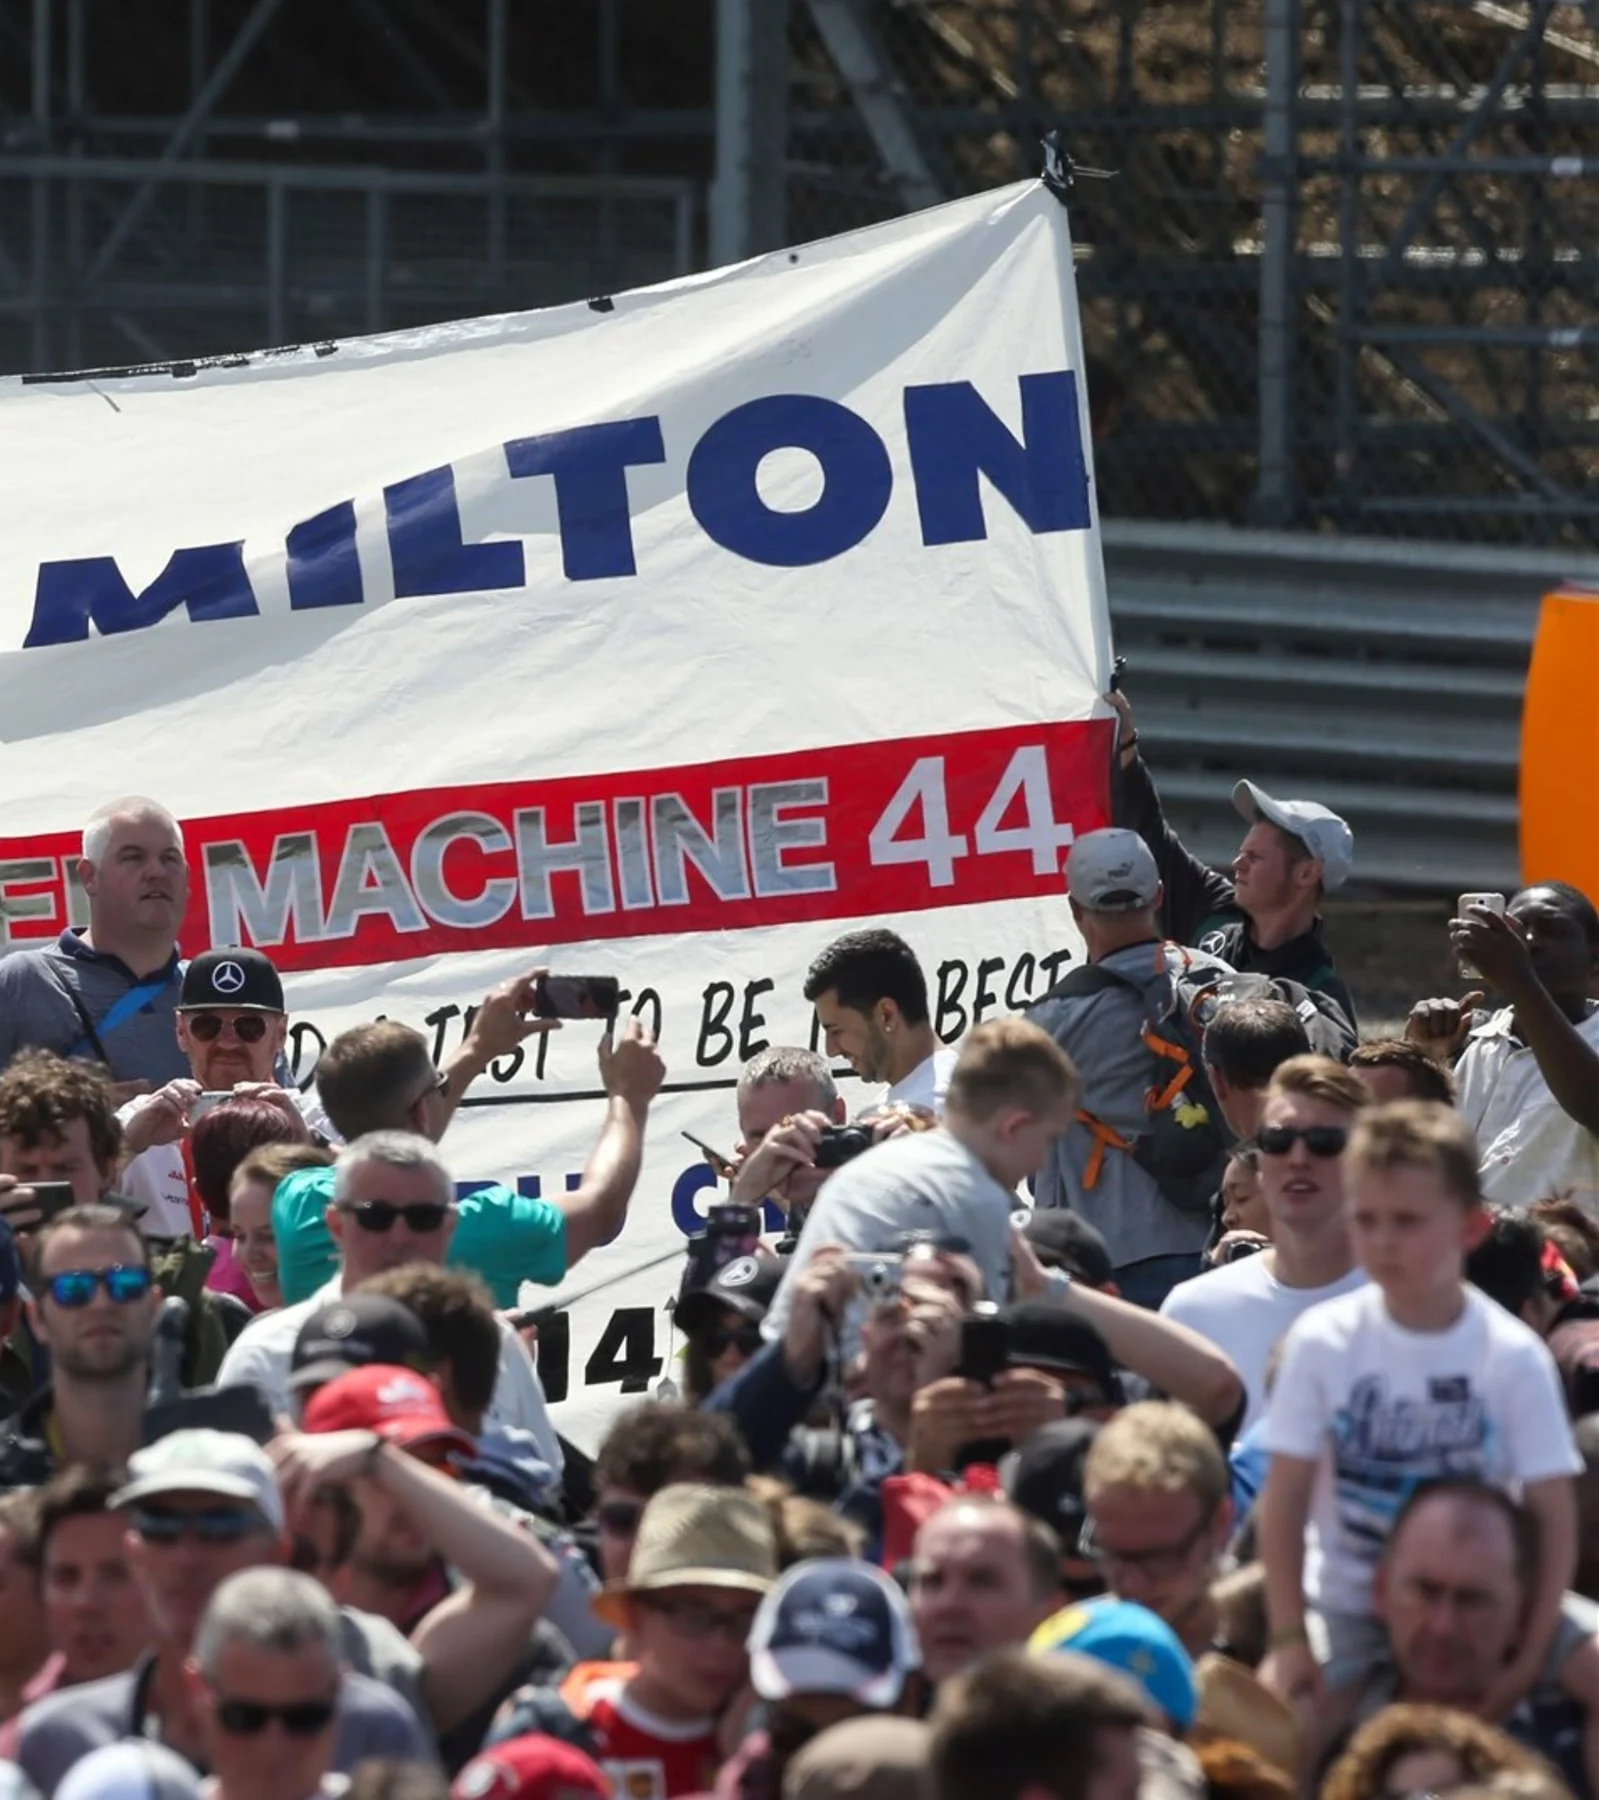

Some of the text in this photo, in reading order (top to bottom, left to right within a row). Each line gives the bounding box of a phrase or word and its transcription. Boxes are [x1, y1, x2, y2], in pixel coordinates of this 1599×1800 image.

[200, 776, 837, 949] MACHINE
[867, 744, 1073, 888] 44
[695, 977, 776, 1068] BE
